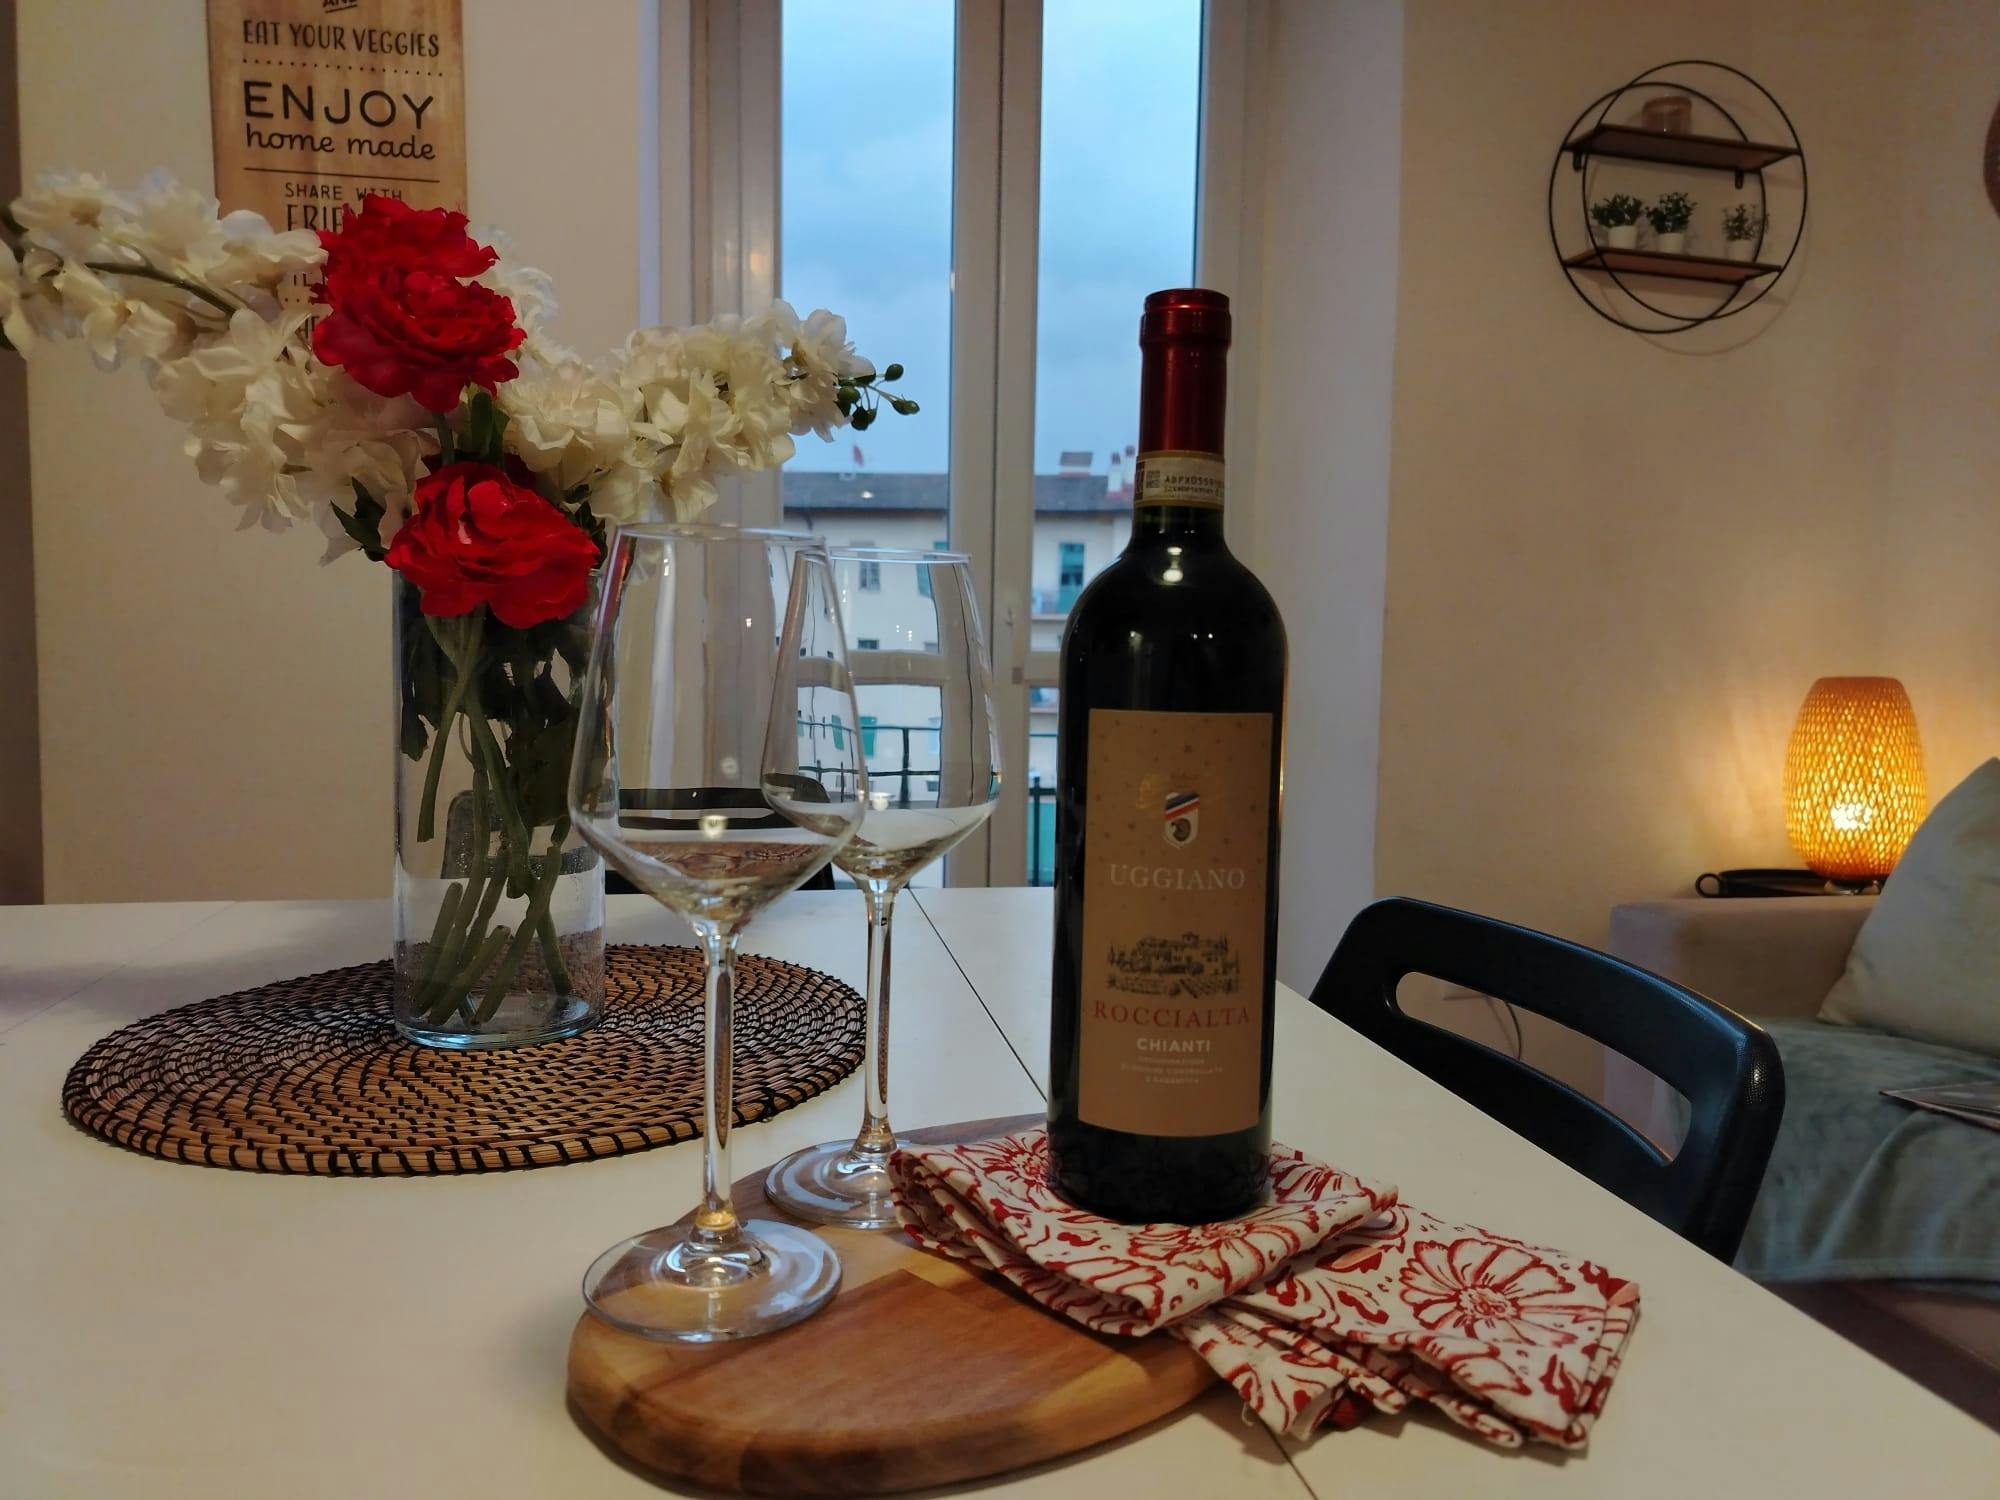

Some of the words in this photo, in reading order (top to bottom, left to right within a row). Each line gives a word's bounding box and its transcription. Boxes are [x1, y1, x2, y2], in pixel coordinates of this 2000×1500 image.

[243, 20, 281, 45] EAT
[289, 23, 347, 50] YOUR
[353, 28, 440, 57] VEGGIES
[243, 81, 434, 129] ENJOY
[246, 123, 335, 153] home
[347, 134, 436, 161] made
[285, 182, 343, 201] SHARE
[1110, 863, 1246, 891] UGGIANO
[1094, 1000, 1250, 1029] ROCCIALTA
[1136, 1037, 1211, 1053] CHIANTI
